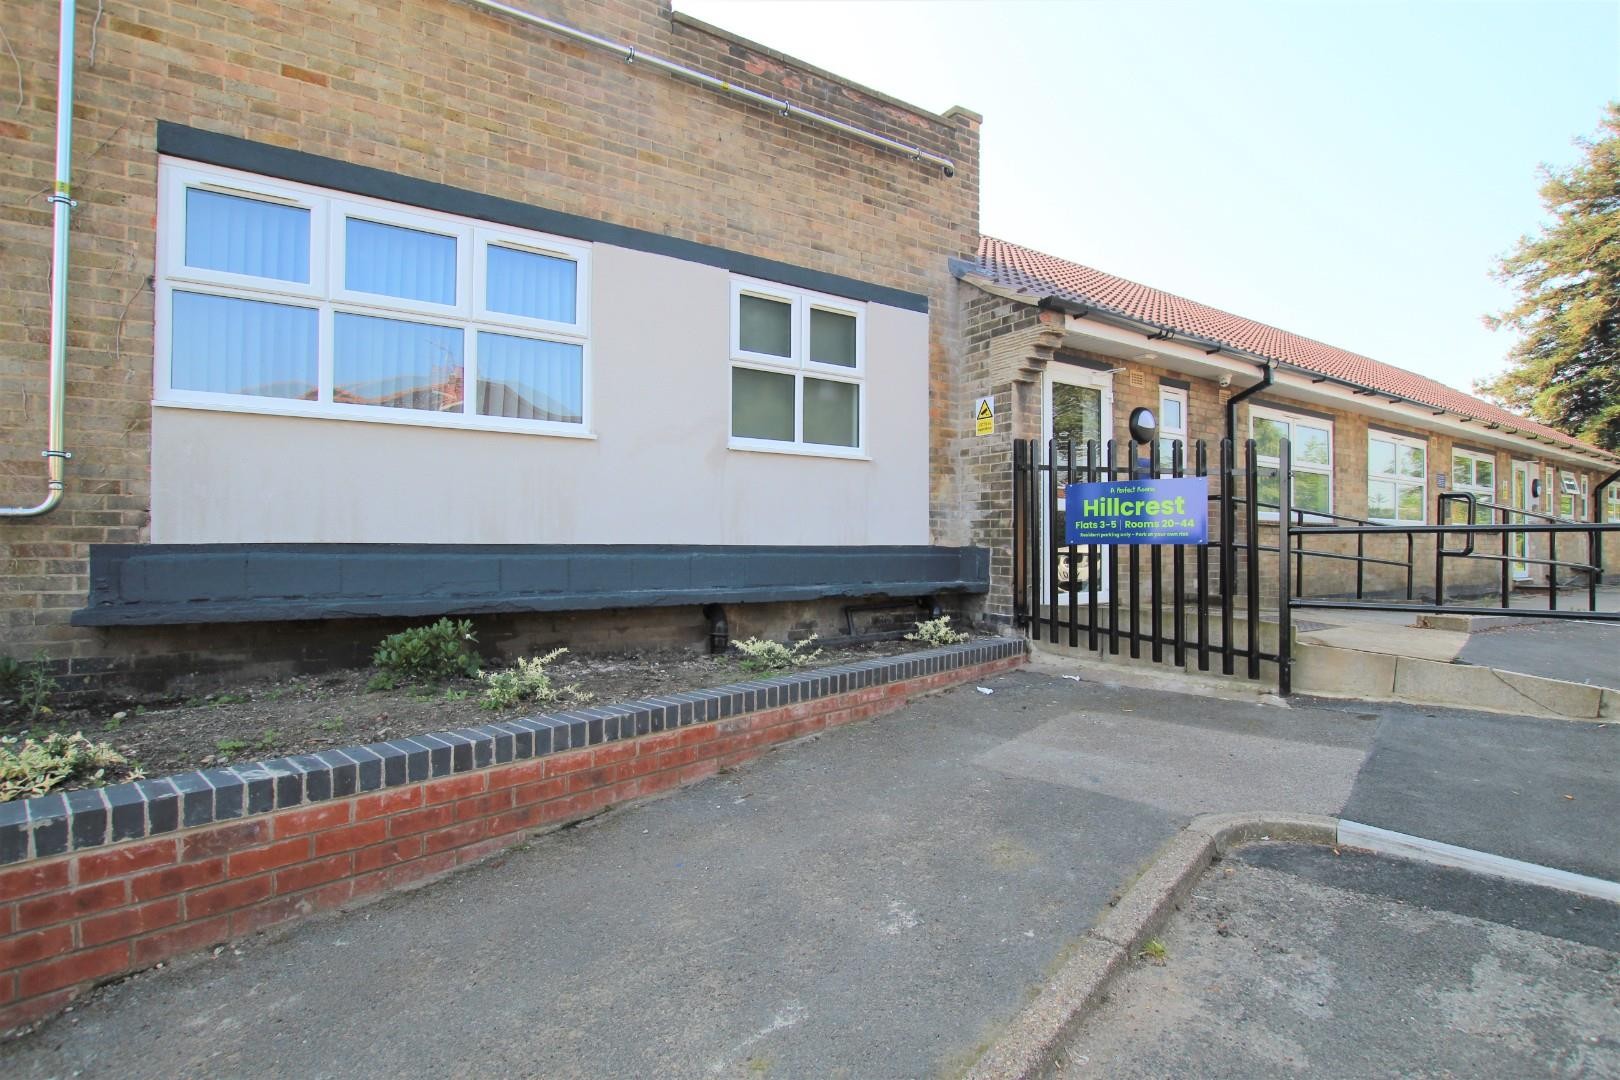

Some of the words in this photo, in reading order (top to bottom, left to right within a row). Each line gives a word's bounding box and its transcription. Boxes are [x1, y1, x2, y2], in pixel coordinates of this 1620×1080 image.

[1083, 496, 1185, 517] Hillcrest
[1075, 521, 1098, 529] Flats
[1099, 520, 1117, 529] 3-5
[1124, 520, 1159, 529] Rooms
[1162, 519, 1195, 528] 20-44
